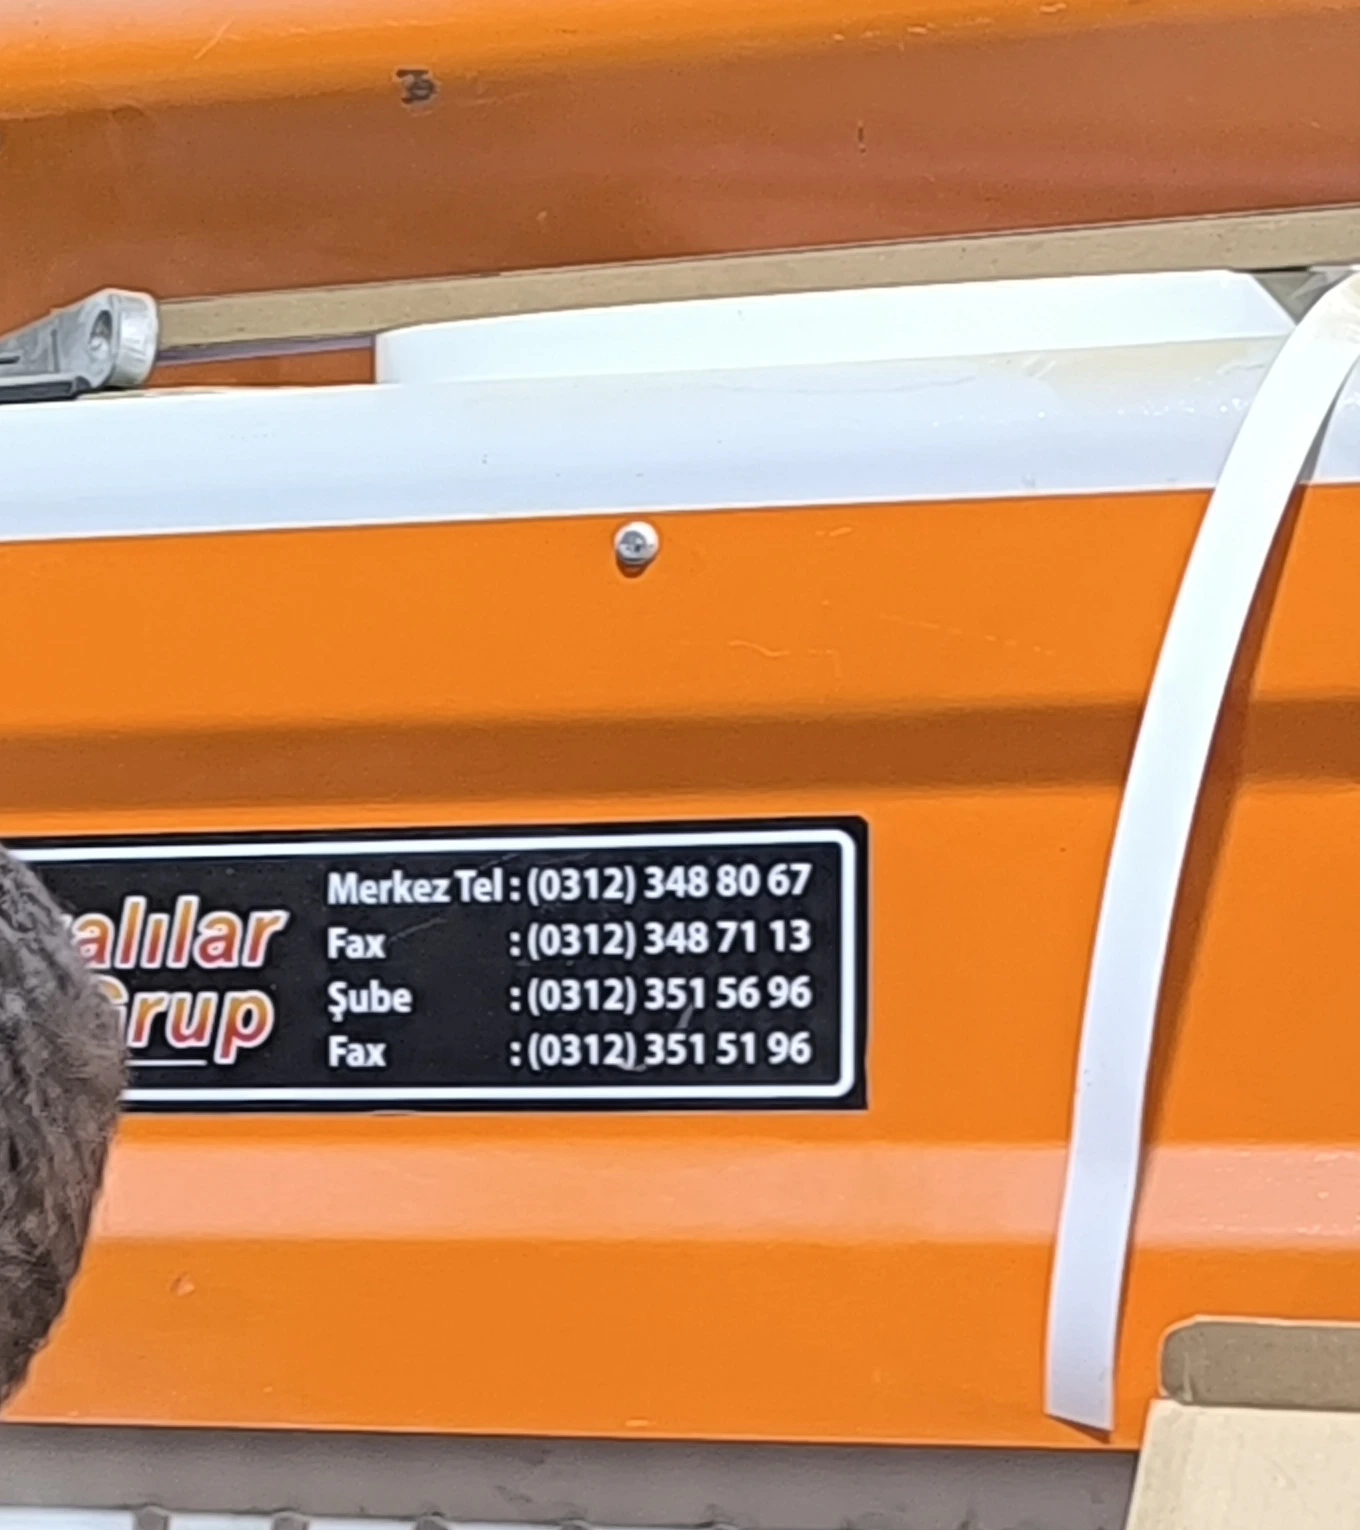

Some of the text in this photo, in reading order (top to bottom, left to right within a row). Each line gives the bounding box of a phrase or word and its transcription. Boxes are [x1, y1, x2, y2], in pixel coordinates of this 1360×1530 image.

[327, 869, 451, 905] Merkez
[453, 867, 504, 903] Tel
[643, 865, 709, 898] 348
[716, 864, 761, 896] 80
[767, 862, 812, 896] 67
[59, 894, 290, 969] alılar
[327, 926, 387, 959] Fax
[643, 921, 709, 954] 348
[716, 920, 757, 952] 71
[769, 918, 811, 952] 13
[88, 974, 275, 1065] rup
[327, 979, 413, 1023] Şube
[643, 976, 706, 1010] 351
[716, 975, 761, 1009] 56
[767, 974, 812, 1009] 96
[327, 1035, 387, 1068] Fax
[643, 1032, 706, 1065] 351
[716, 1031, 757, 1065] 51
[767, 1030, 812, 1065] 96
